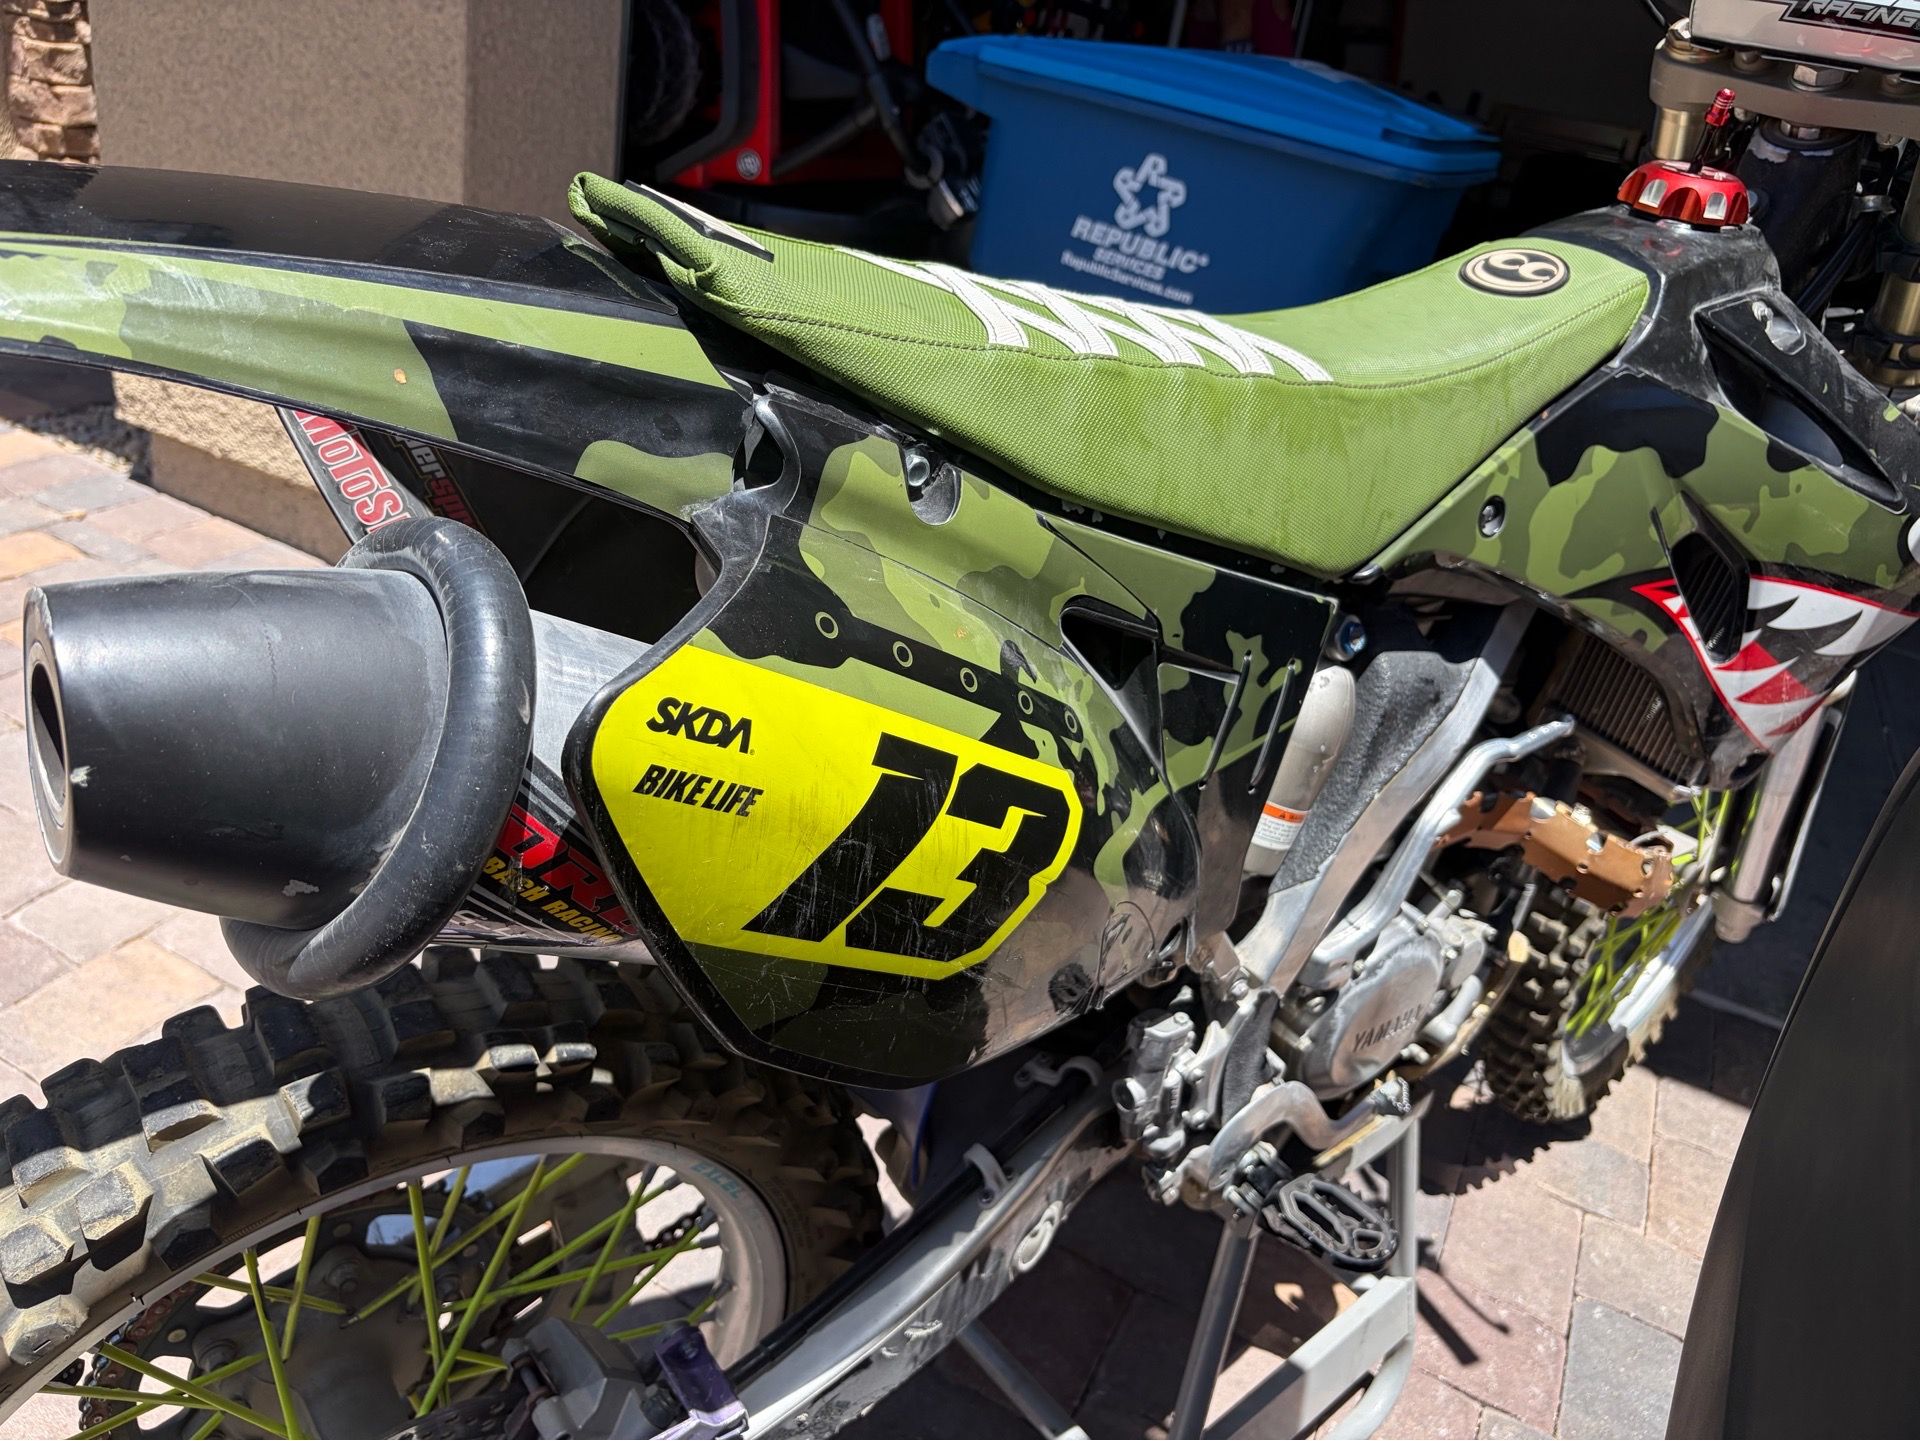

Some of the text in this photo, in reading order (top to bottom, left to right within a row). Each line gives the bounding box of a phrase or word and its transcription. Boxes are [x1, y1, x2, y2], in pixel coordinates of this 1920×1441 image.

[1801, 0, 1918, 28] RACING
[1069, 214, 1198, 274] REPUBLIC
[1092, 246, 1167, 281] SERVICES
[293, 410, 412, 534] MOTOS
[646, 697, 752, 755] SKDA
[740, 732, 1070, 962] 73
[1352, 1003, 1423, 1054] YAMAHA
[689, 1161, 745, 1201] EXCEL
